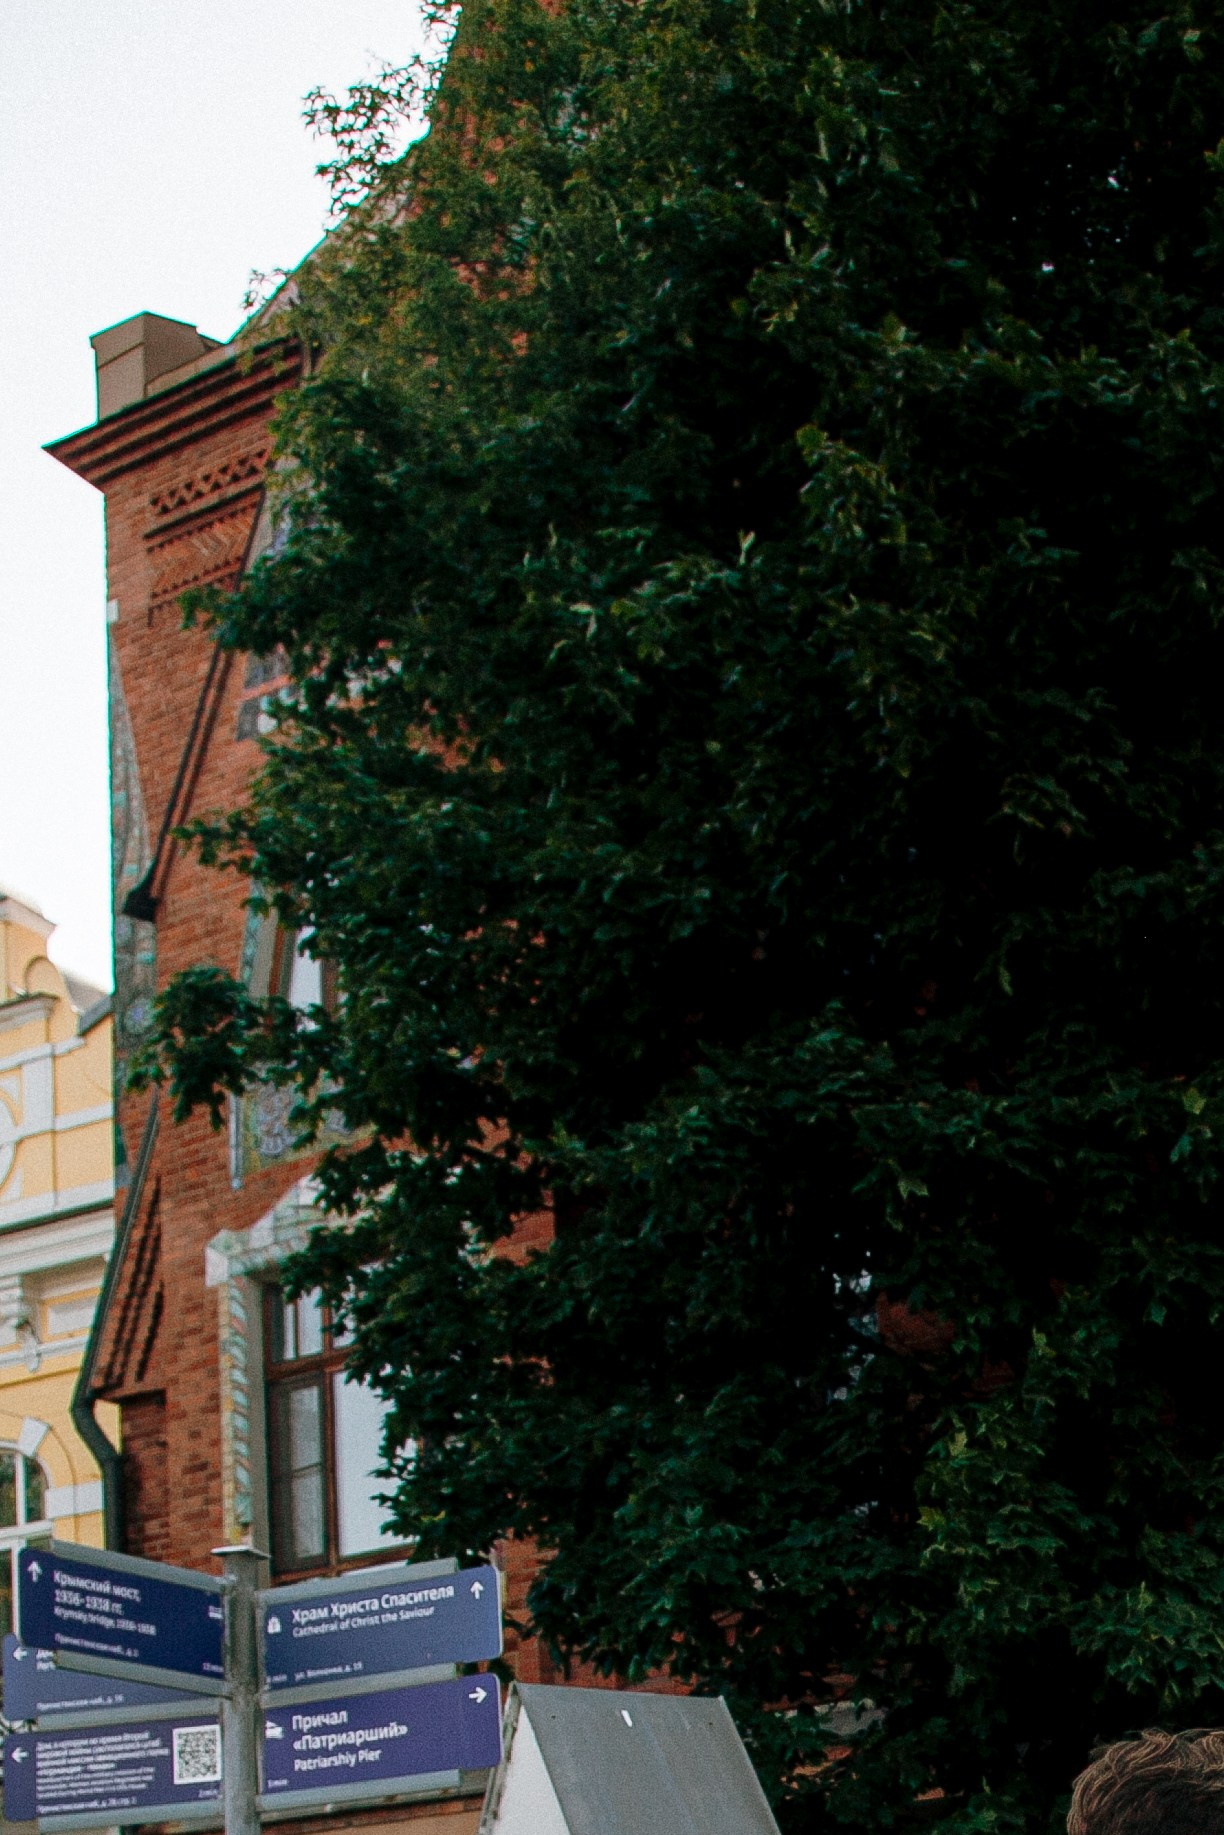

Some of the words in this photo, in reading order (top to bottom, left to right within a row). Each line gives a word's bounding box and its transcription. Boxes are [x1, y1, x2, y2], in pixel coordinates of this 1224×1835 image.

[54, 1570, 111, 1592] Крымский
[292, 1606, 329, 1625] Храм
[330, 1598, 379, 1619] Христа
[381, 1585, 455, 1609] Спасителя
[292, 1621, 338, 1638] Cathedral
[339, 1618, 350, 1630] of
[351, 1614, 380, 1628] Christ
[381, 1611, 398, 1623] the
[399, 1606, 435, 1621] Saviour
[292, 1710, 348, 1733] Причал
[293, 1721, 408, 1751] «Патриарший»
[294, 1751, 357, 1772] Patriarshiy
[358, 1747, 382, 1763] Pier
